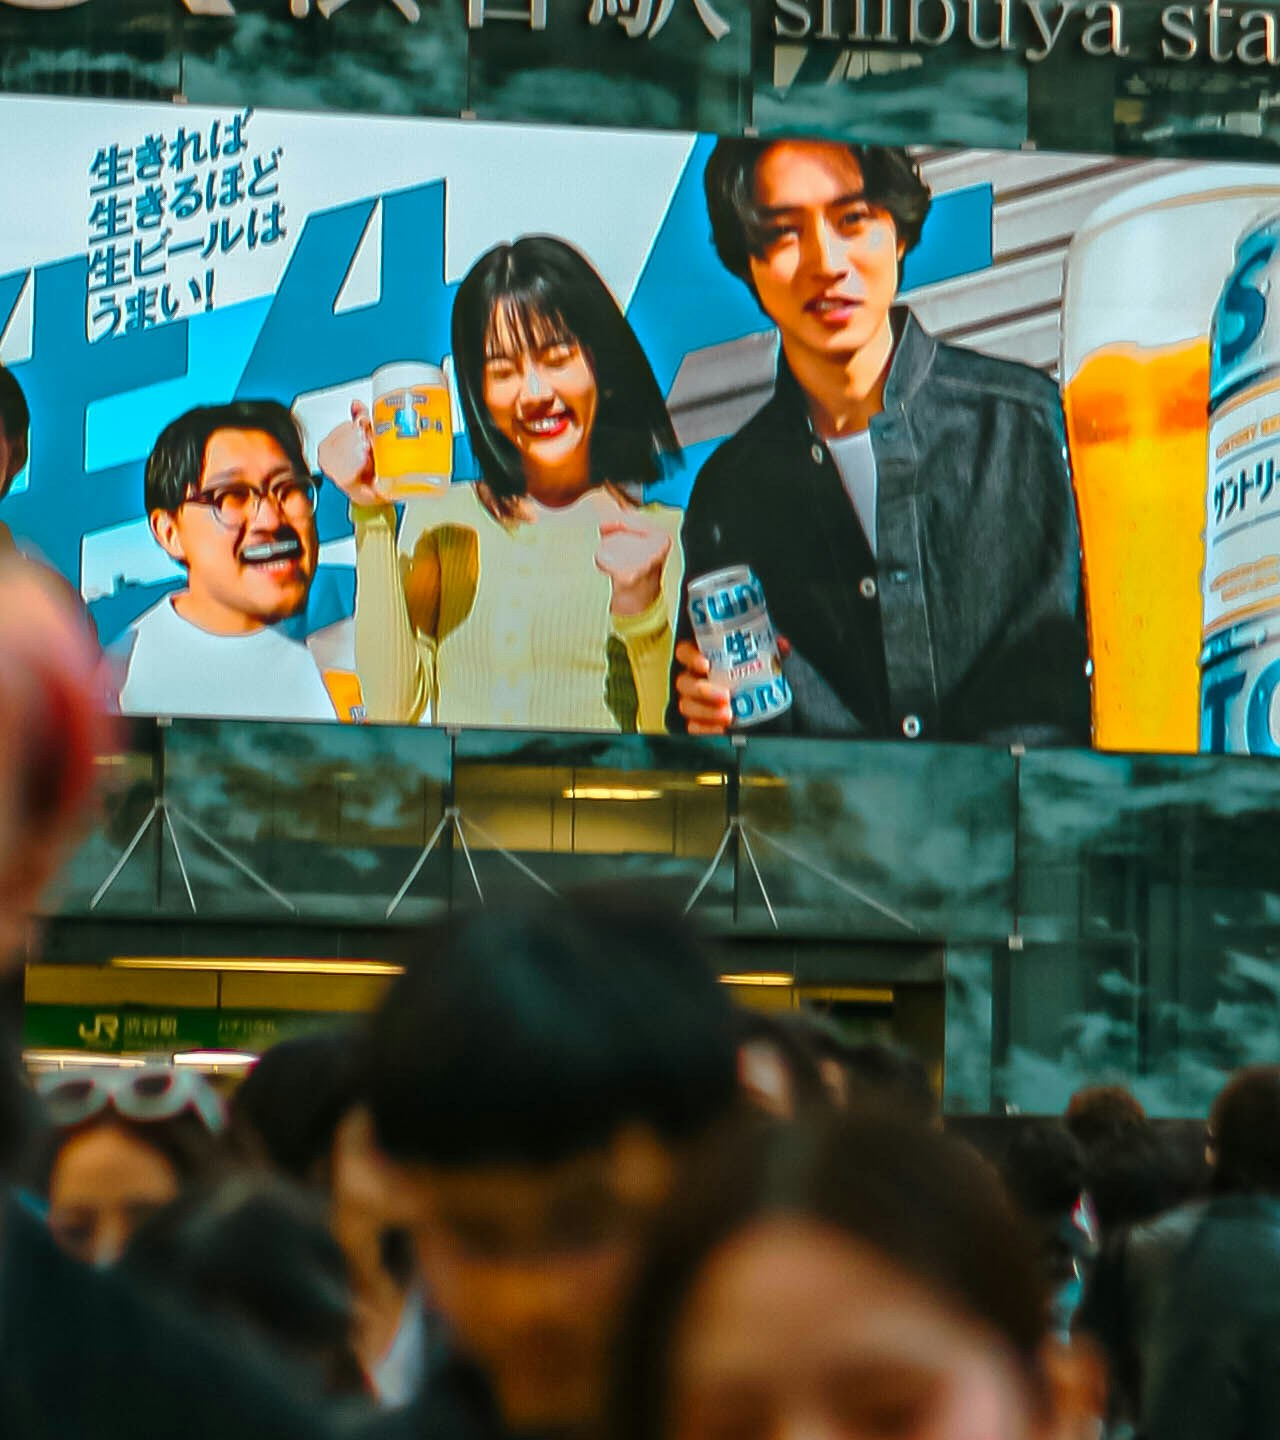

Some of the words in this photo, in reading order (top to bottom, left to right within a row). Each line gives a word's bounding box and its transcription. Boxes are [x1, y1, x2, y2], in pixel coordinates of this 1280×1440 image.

[88, 147, 283, 245] 生きるほど
[89, 106, 254, 195] 生きれば
[87, 201, 287, 293] 生ビールは
